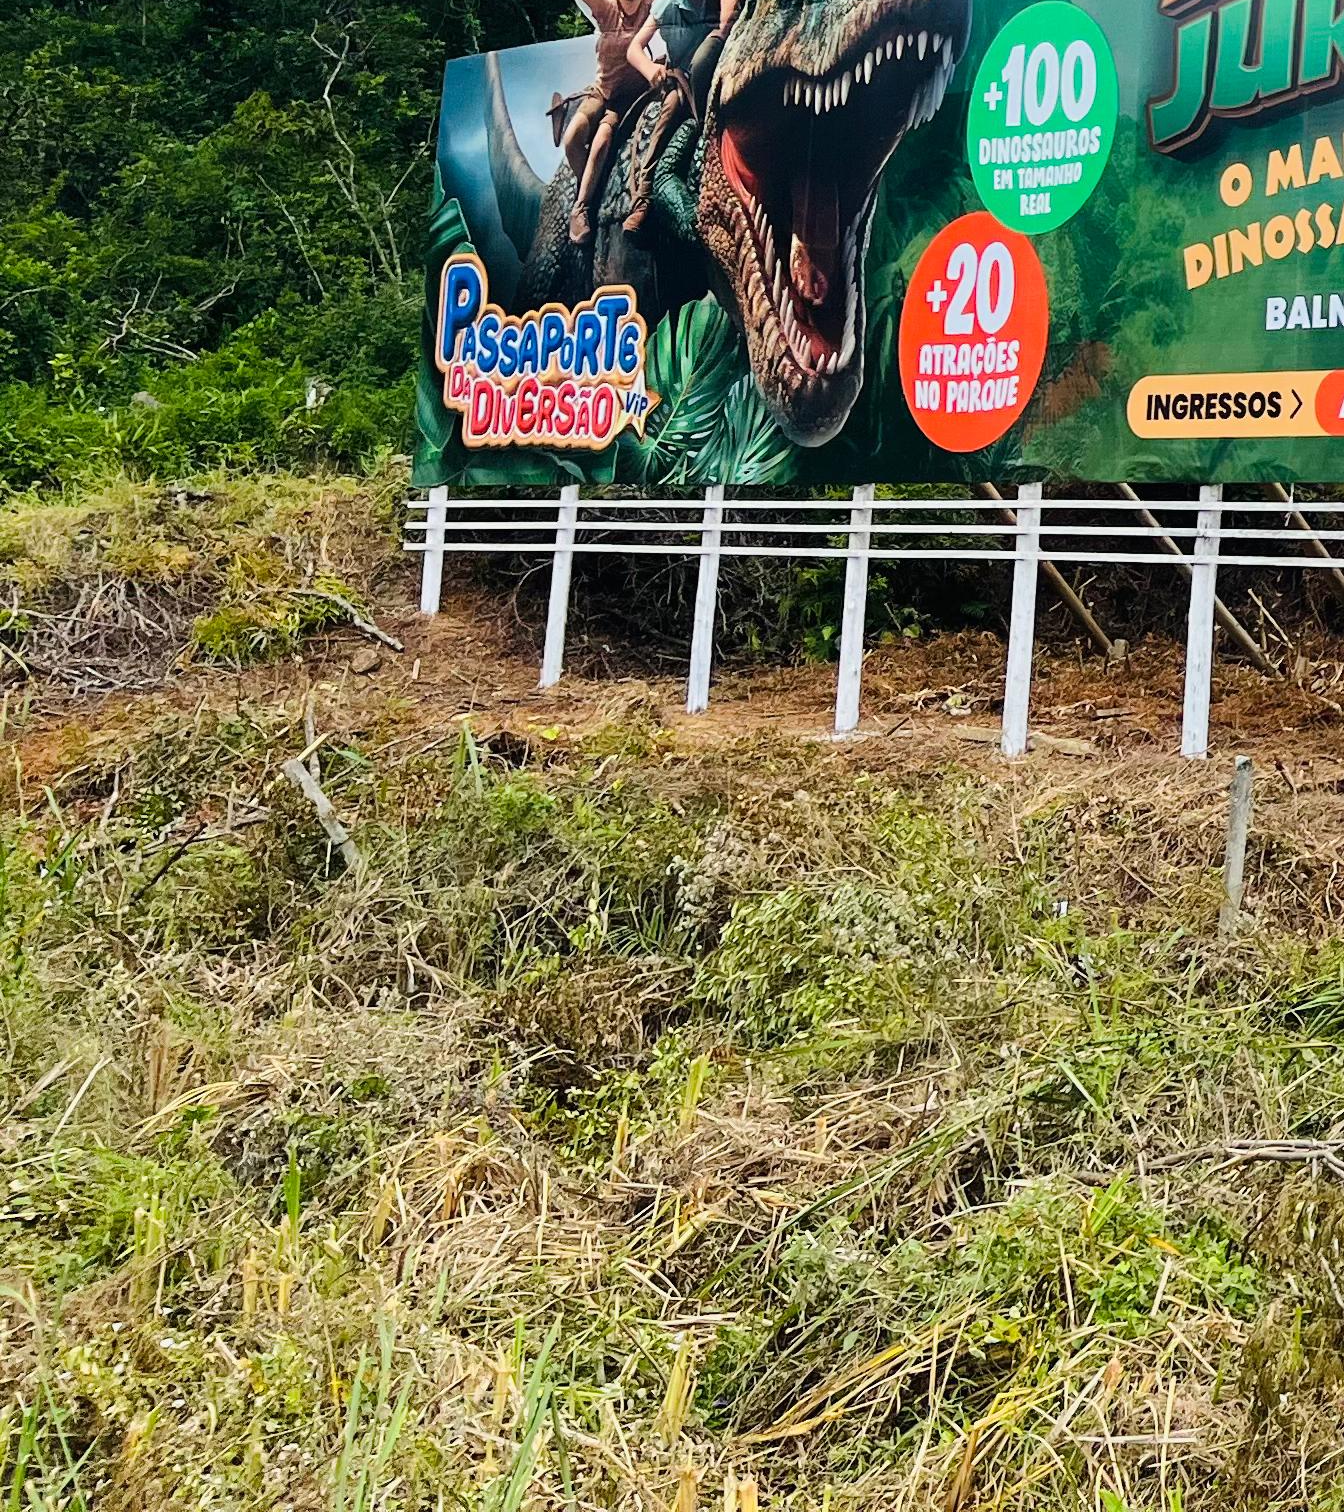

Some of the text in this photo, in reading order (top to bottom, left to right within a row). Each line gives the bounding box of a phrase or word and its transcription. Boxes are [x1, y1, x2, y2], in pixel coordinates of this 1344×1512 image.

[982, 39, 1098, 127] +100
[978, 126, 1100, 166] DINOSSAUROS
[994, 162, 1082, 188] EM TAMANHO
[1220, 161, 1253, 208] O
[1020, 190, 1051, 216] REAL
[926, 242, 1015, 336] +20
[920, 337, 1019, 378] ATRAÇÕES
[452, 364, 471, 402] DA
[916, 379, 1019, 416] NO PARQUE
[1146, 390, 1281, 422] INGRESSOS
